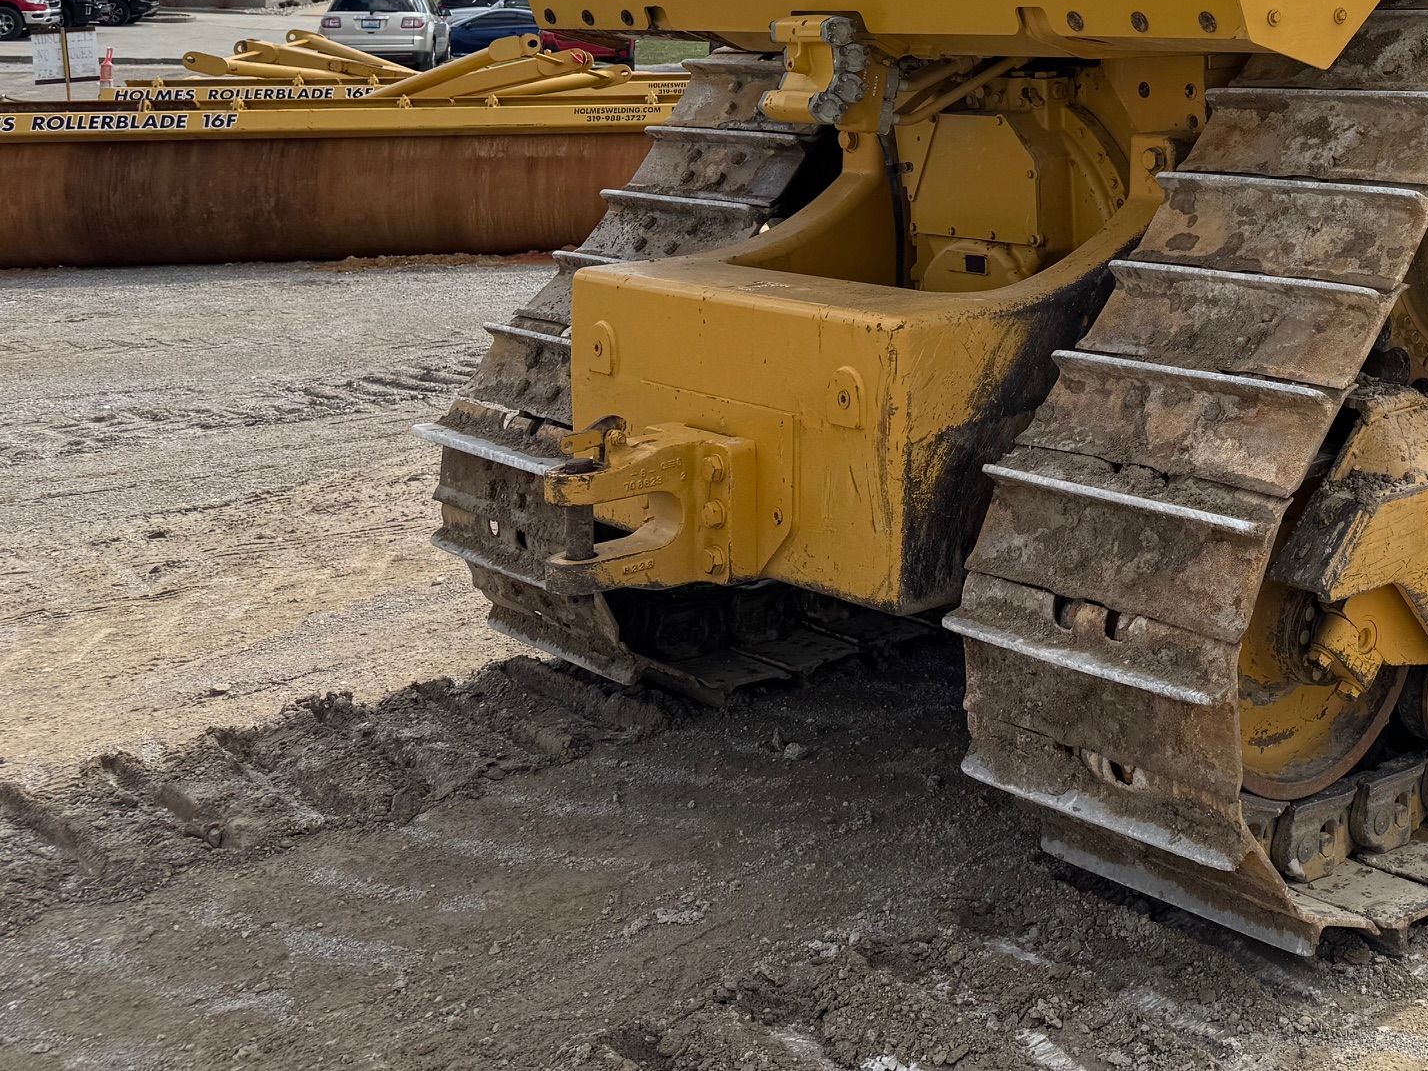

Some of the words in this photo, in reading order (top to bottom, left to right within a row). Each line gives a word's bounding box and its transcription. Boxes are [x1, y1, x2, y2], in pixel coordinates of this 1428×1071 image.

[115, 88, 196, 101] HOLMES
[207, 88, 334, 100] ROLLERBLADE
[574, 106, 661, 115] HOLMESWELDING.COM
[31, 114, 188, 131] ROLLERBLADE
[203, 113, 238, 128] 16F
[587, 114, 647, 122] 319-988-3727
